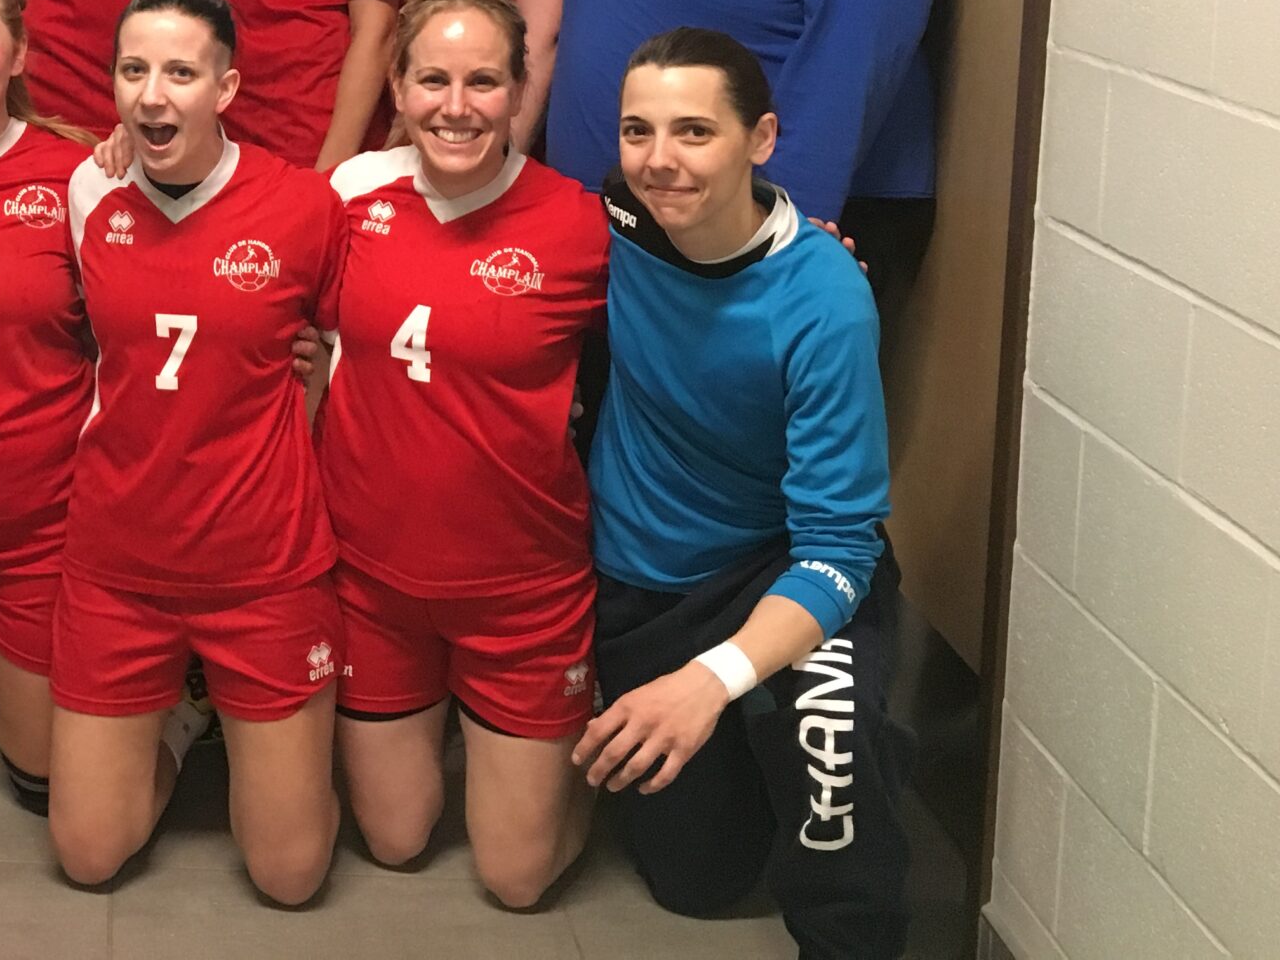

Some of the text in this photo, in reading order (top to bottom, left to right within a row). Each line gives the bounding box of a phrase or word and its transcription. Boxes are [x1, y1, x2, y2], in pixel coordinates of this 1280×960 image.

[3, 199, 68, 224] CHAMPLAIN
[105, 232, 134, 245] errea
[213, 256, 281, 279] CHAMPLAIN
[469, 258, 546, 291] CHAMPLAIN
[154, 313, 198, 391] 7
[390, 304, 432, 383] 4
[792, 638, 855, 851] CHAM
